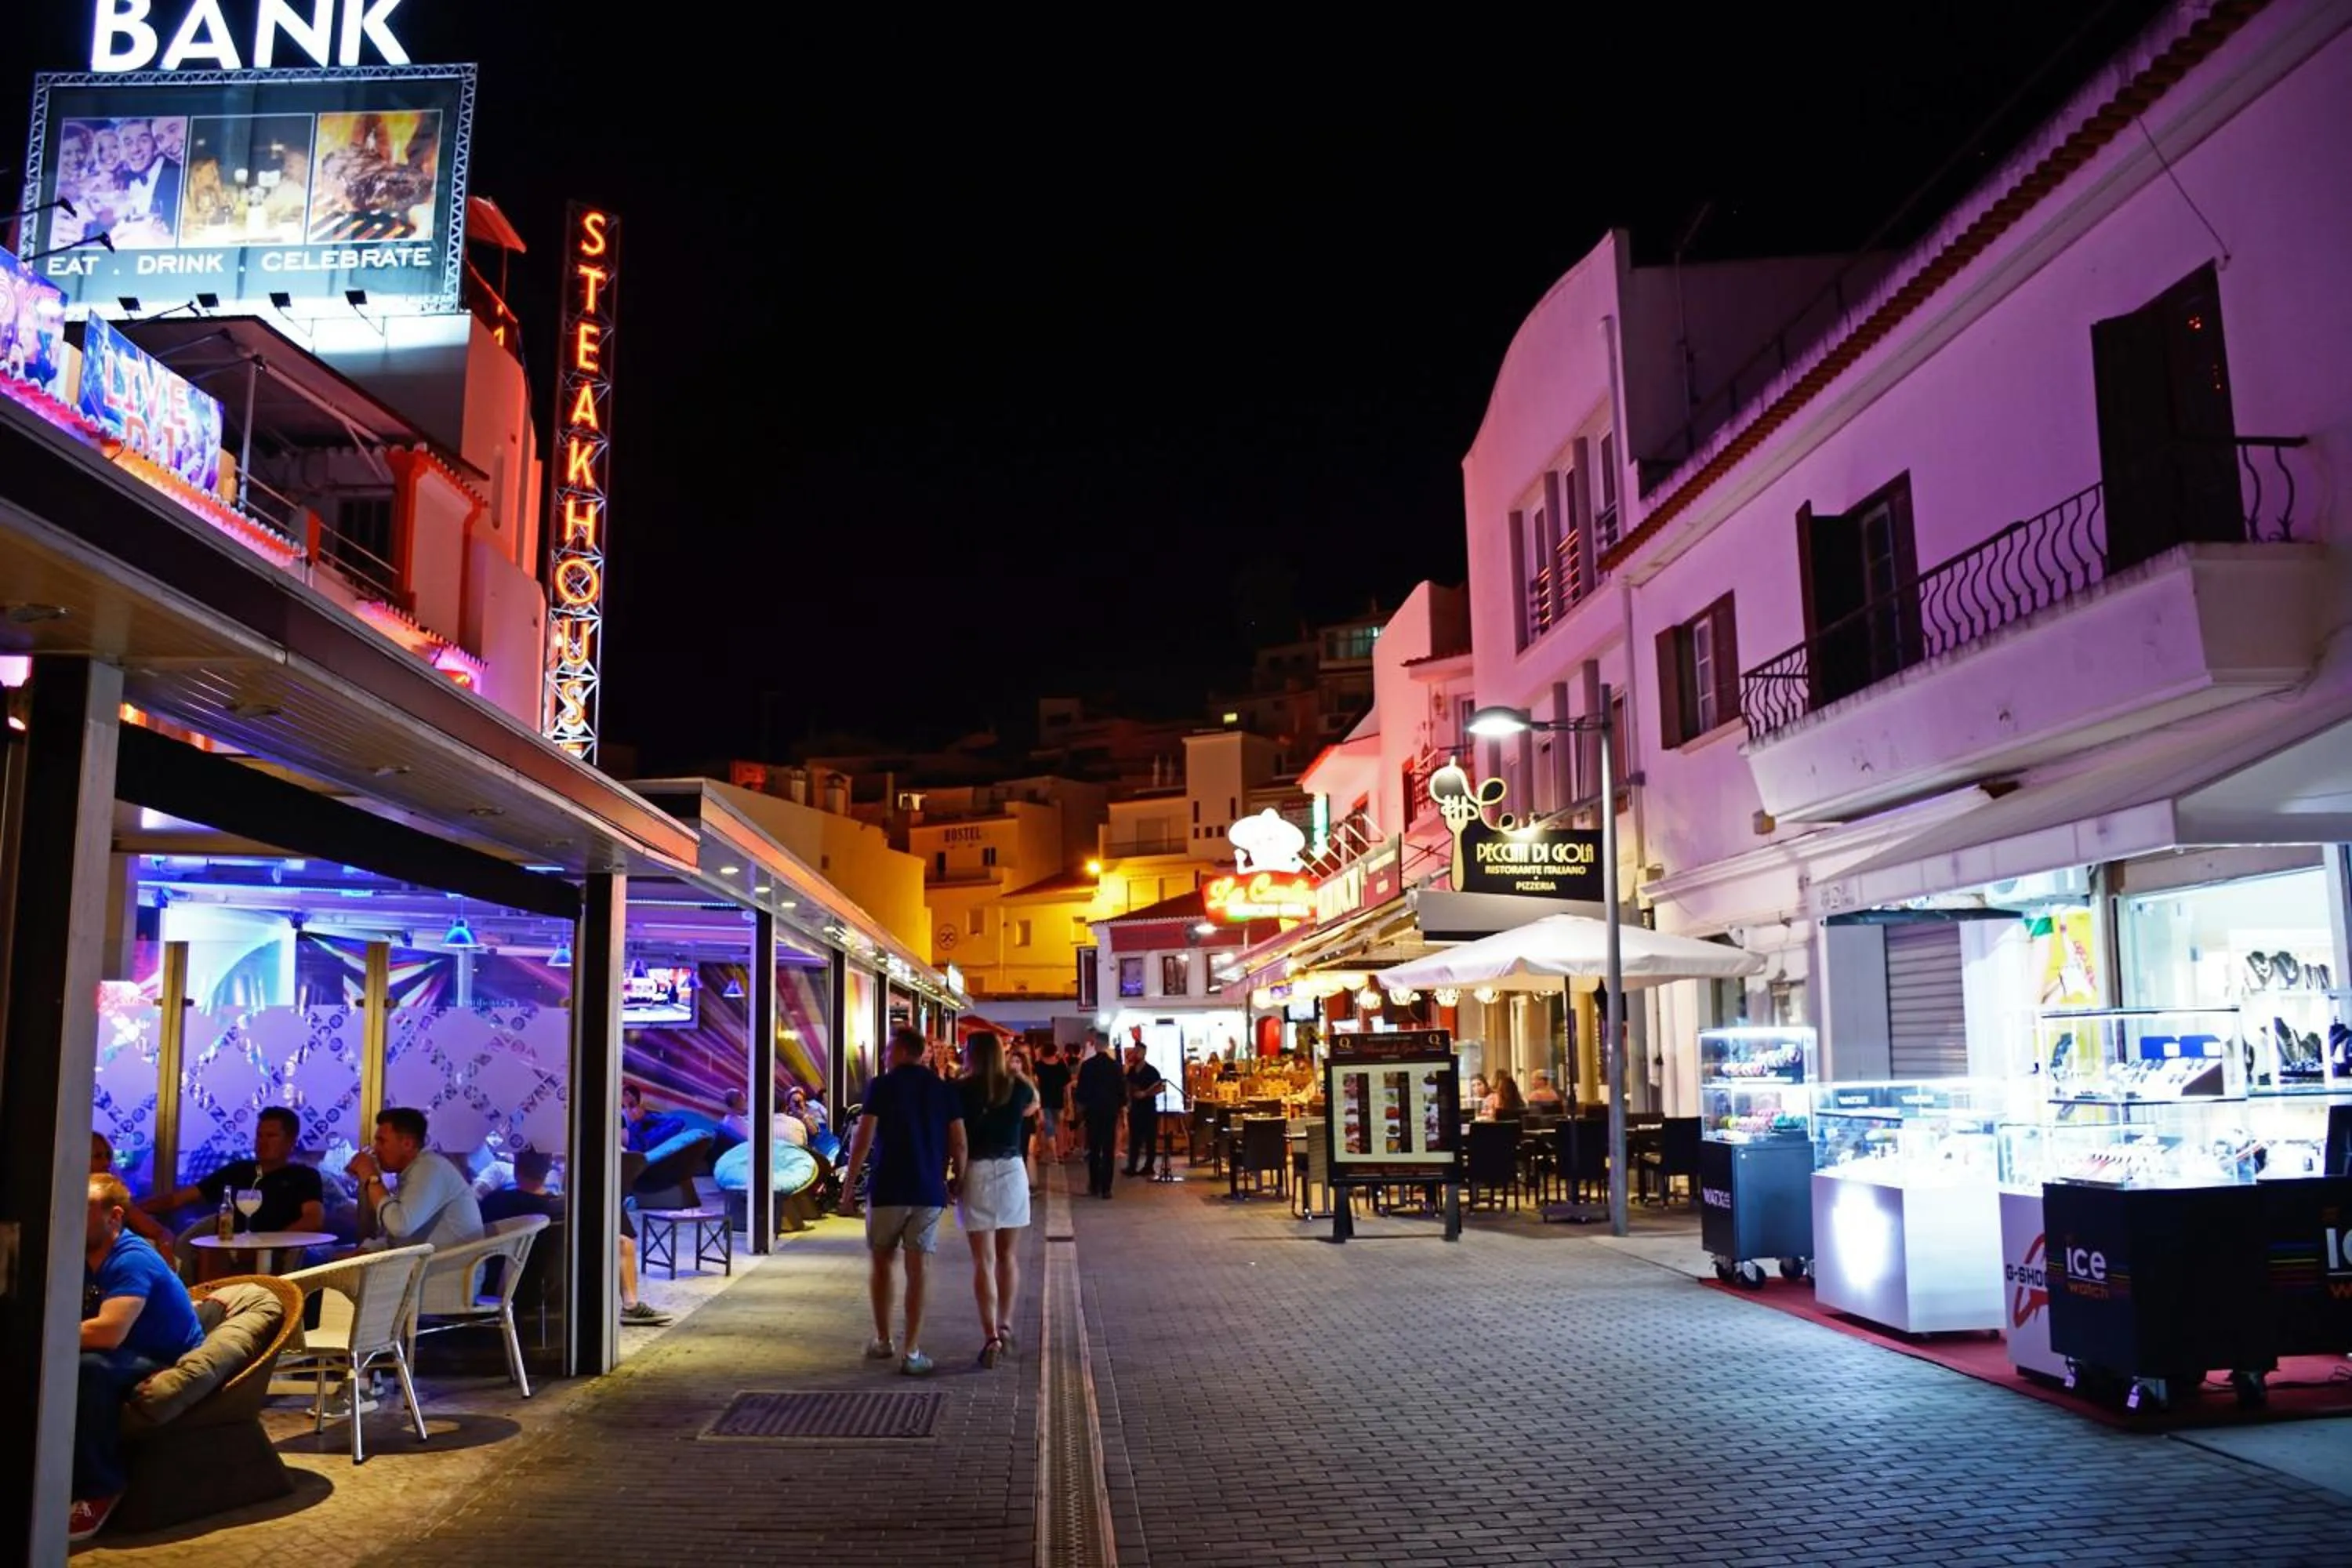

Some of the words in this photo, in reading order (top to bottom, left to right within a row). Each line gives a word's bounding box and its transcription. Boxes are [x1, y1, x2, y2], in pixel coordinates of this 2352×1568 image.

[91, 0, 412, 73] BANK
[47, 256, 100, 275] EAT
[136, 253, 224, 275] DRINK
[261, 247, 433, 272] CELEBRATE
[103, 350, 188, 427] LIVE
[554, 211, 607, 756] STEAKHOUS
[944, 826, 982, 843] HOSTEL
[1532, 843, 1548, 862] DI
[1552, 844, 1594, 862] GOLA
[1485, 865, 1542, 874] RISTORANTE
[1544, 865, 1586, 875] ITALIANO
[1515, 881, 1556, 891] PIZZERIA
[2005, 1264, 2047, 1287] G-SHO
